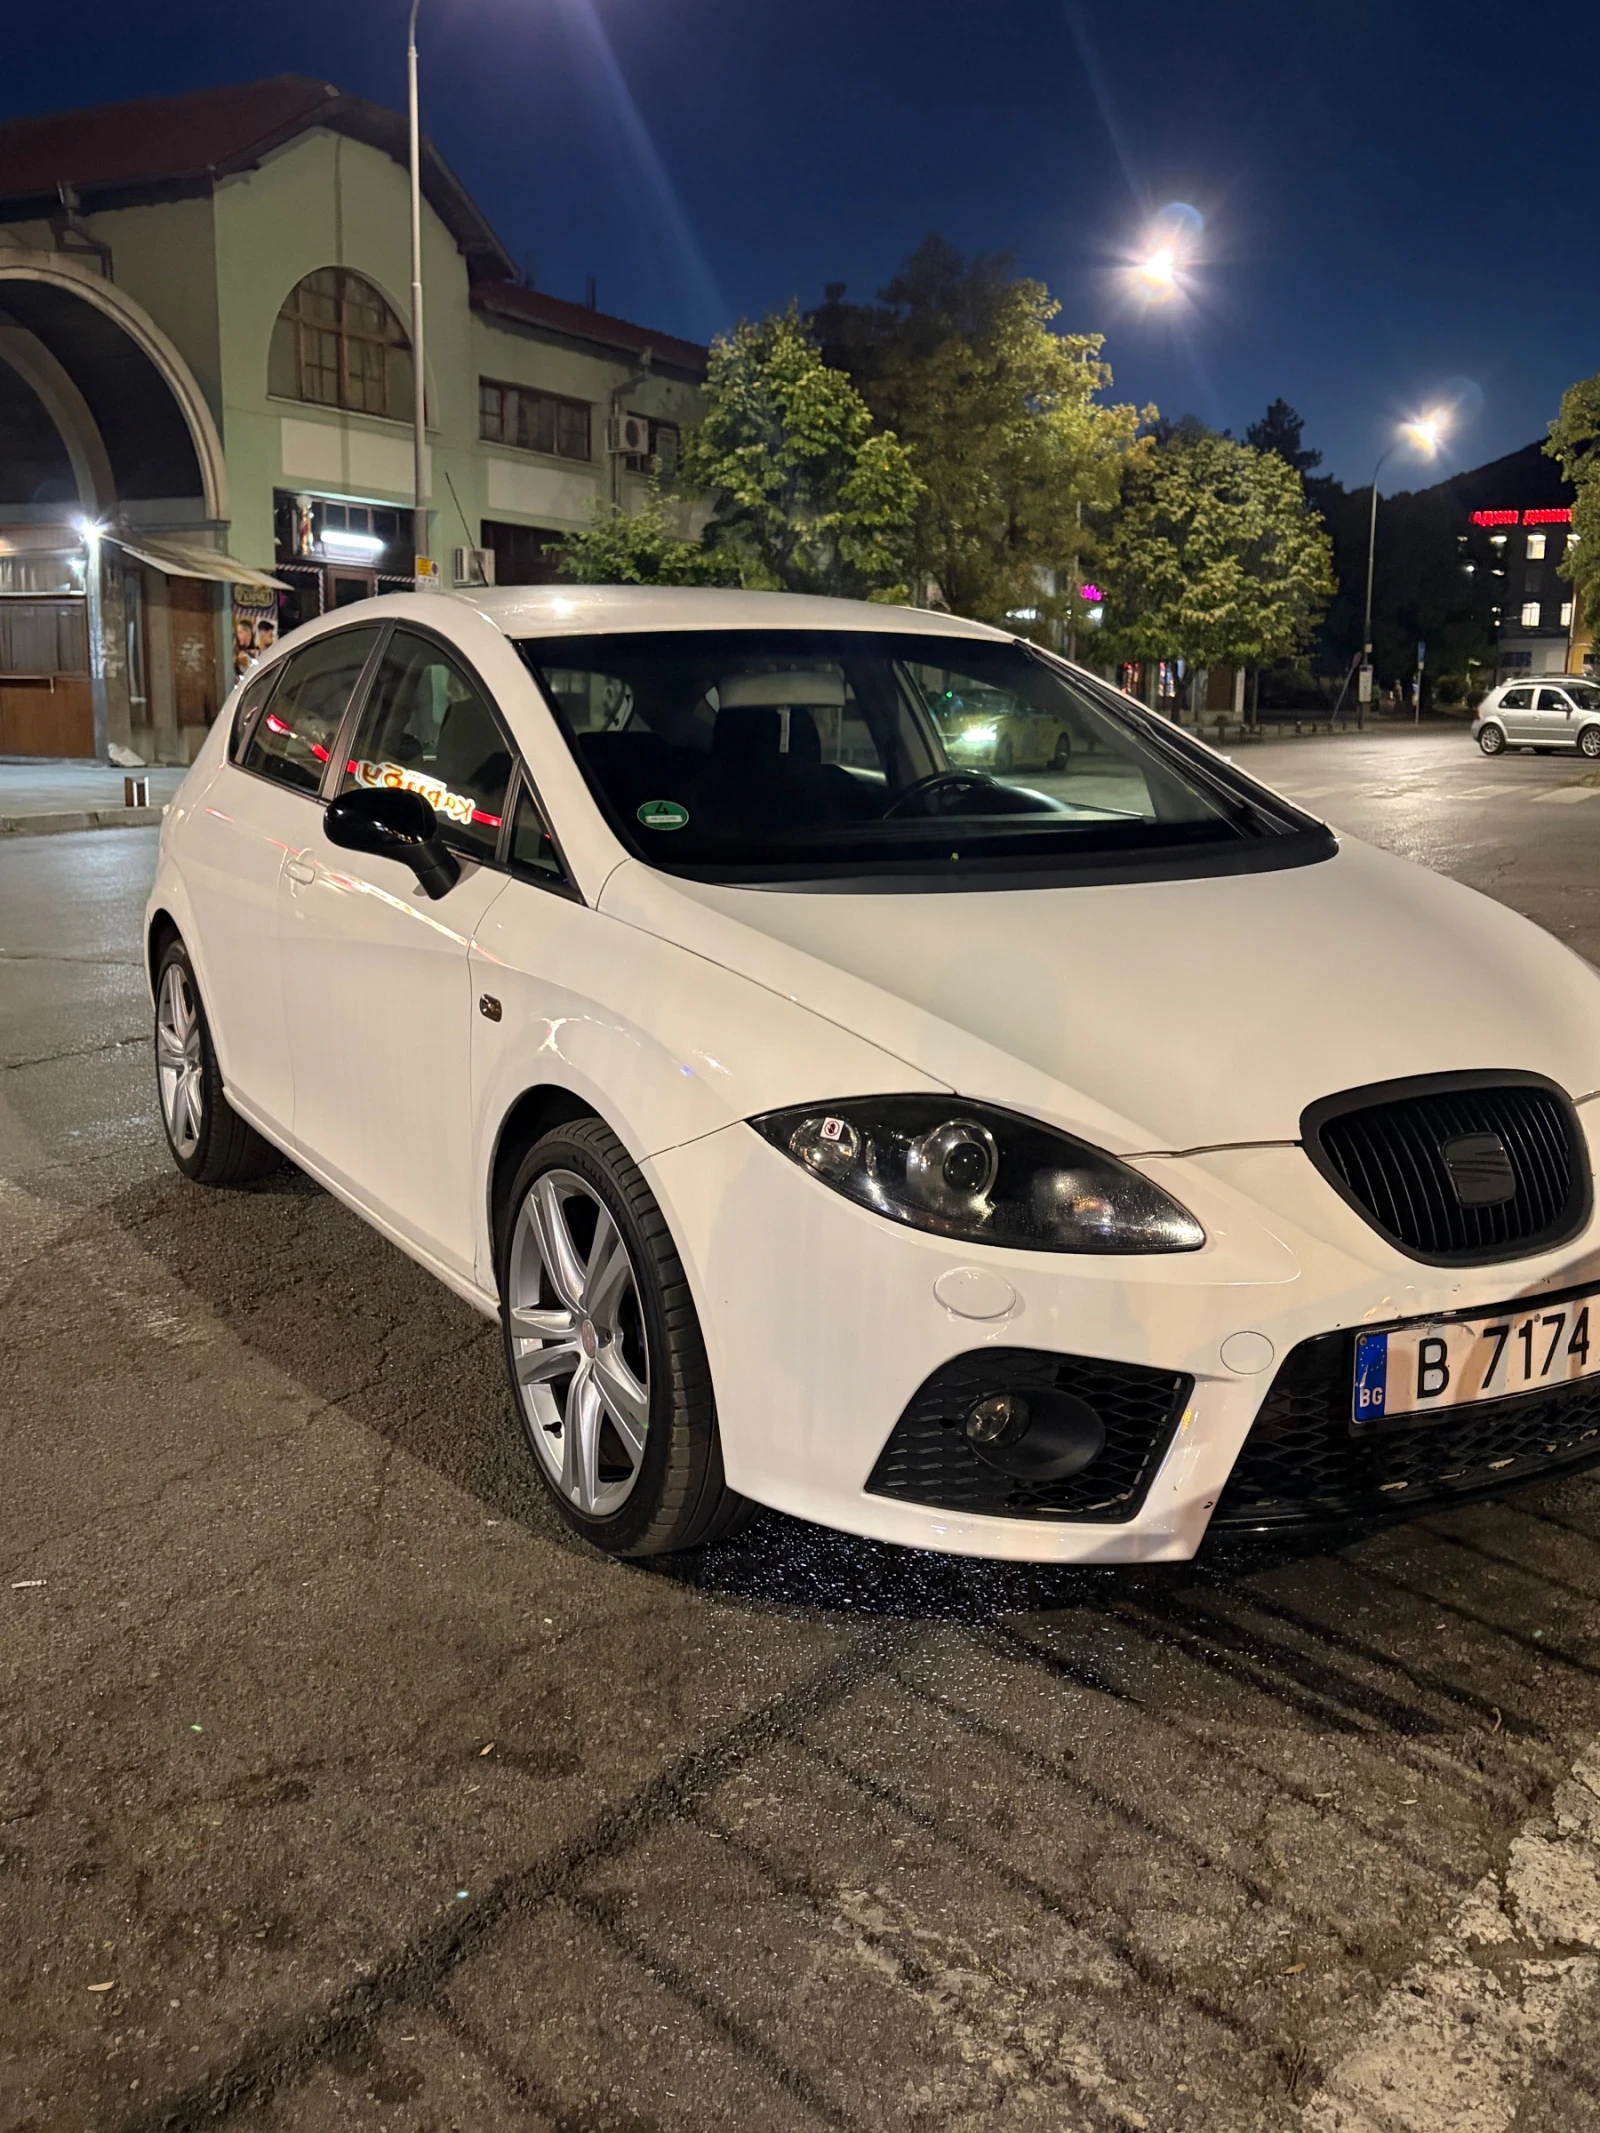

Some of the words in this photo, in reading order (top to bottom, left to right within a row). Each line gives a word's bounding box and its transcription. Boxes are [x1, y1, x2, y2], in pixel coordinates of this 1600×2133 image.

[655, 802, 669, 815] 4
[1417, 1337, 1450, 1400] B
[1481, 1306, 1590, 1390] 7174
[1359, 1387, 1383, 1408] BG
